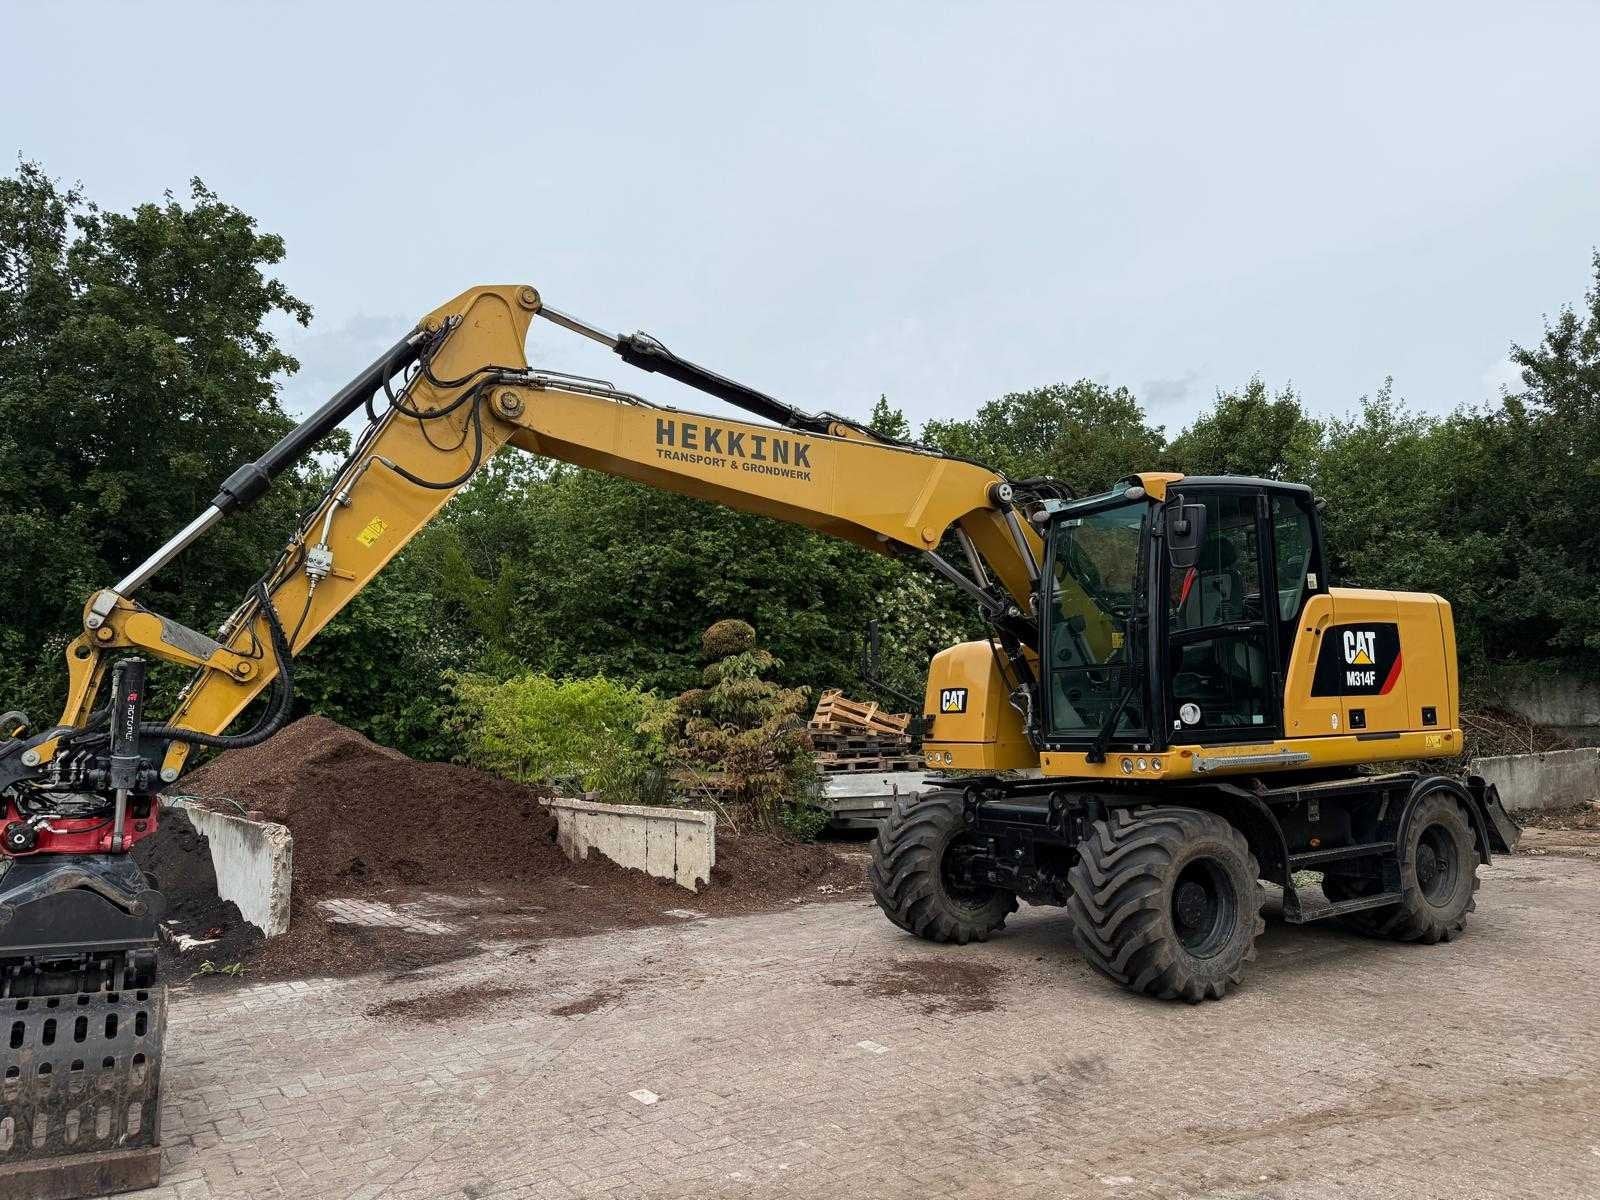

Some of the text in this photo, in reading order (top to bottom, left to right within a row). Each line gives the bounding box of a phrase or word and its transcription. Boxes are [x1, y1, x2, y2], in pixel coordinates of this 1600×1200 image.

[656, 418, 811, 468] HEKKINK
[656, 449, 811, 481] TRANSPORT & GRONDWERK
[1343, 630, 1376, 664] CAT
[1346, 671, 1376, 686] M314F
[942, 690, 965, 711] CAT
